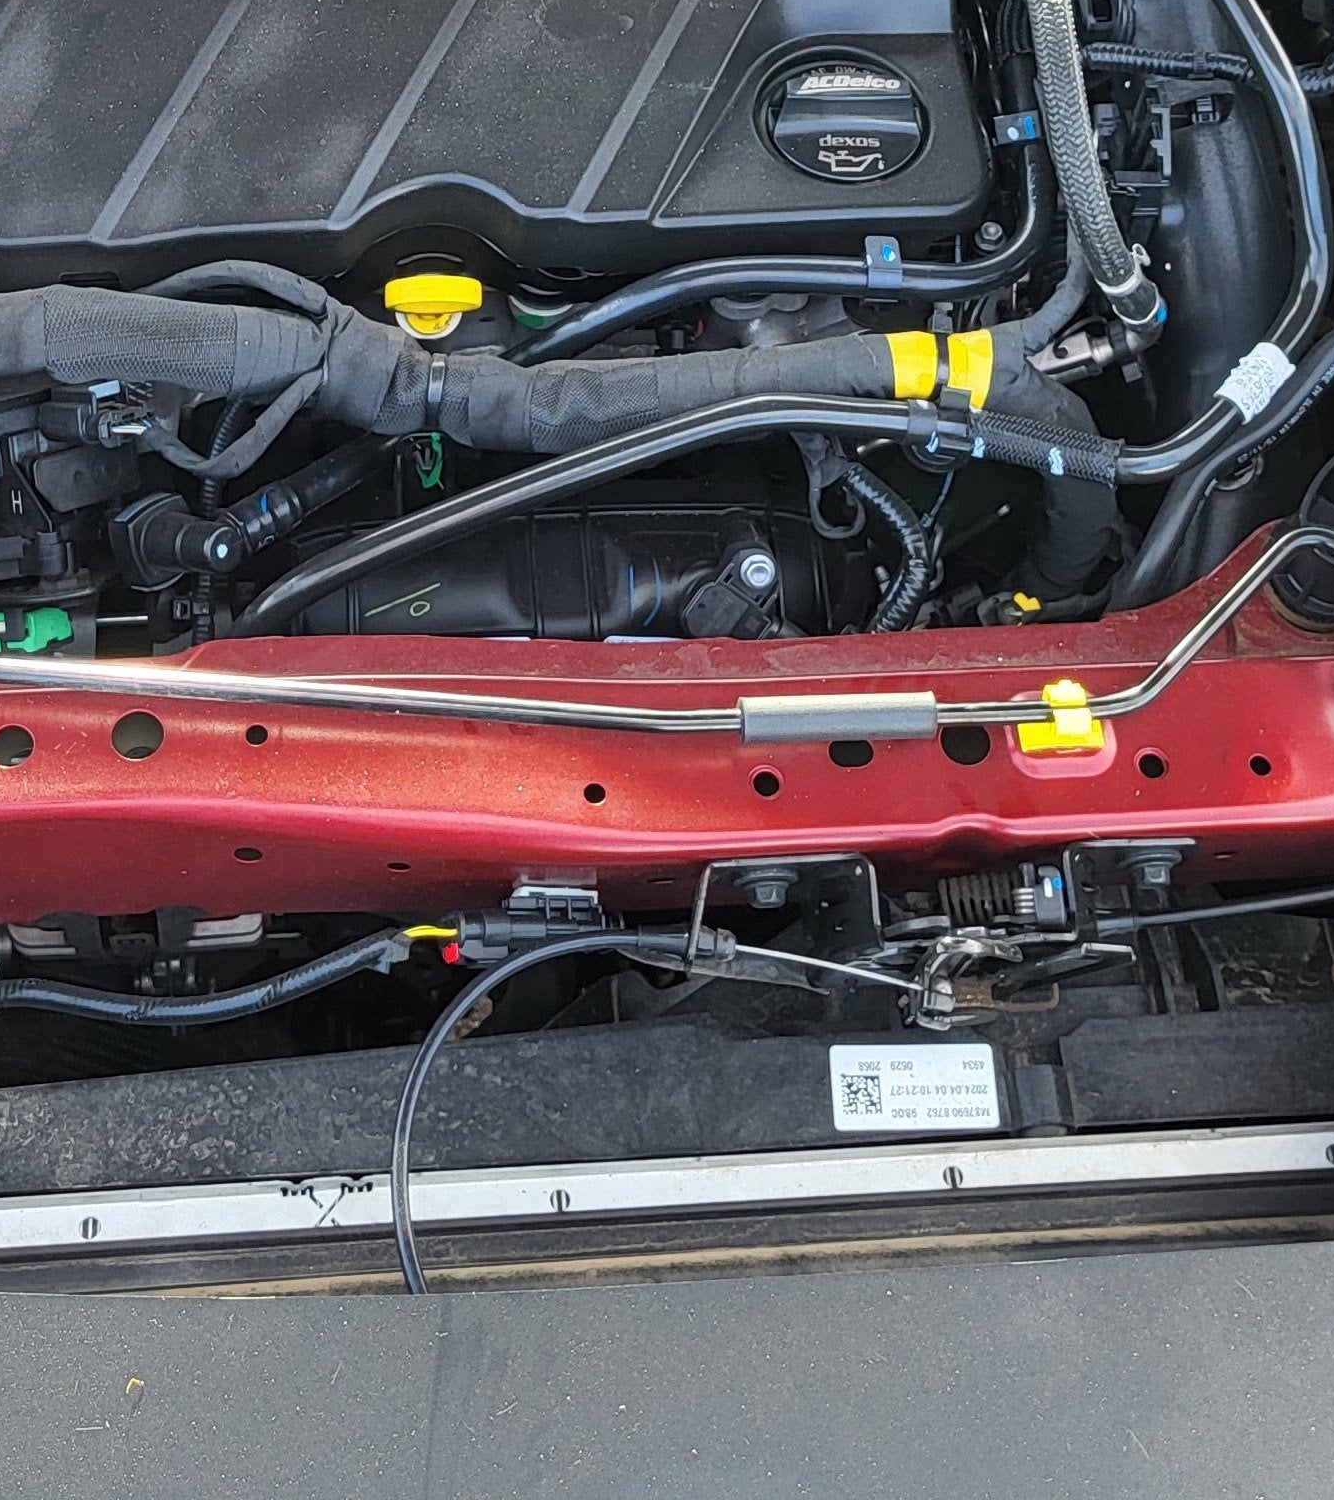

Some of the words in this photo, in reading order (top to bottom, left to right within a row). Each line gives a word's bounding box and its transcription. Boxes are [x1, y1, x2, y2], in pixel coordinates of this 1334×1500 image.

[800, 75, 901, 90] ACDelco
[819, 134, 881, 147] dexos
[11, 489, 23, 515] H
